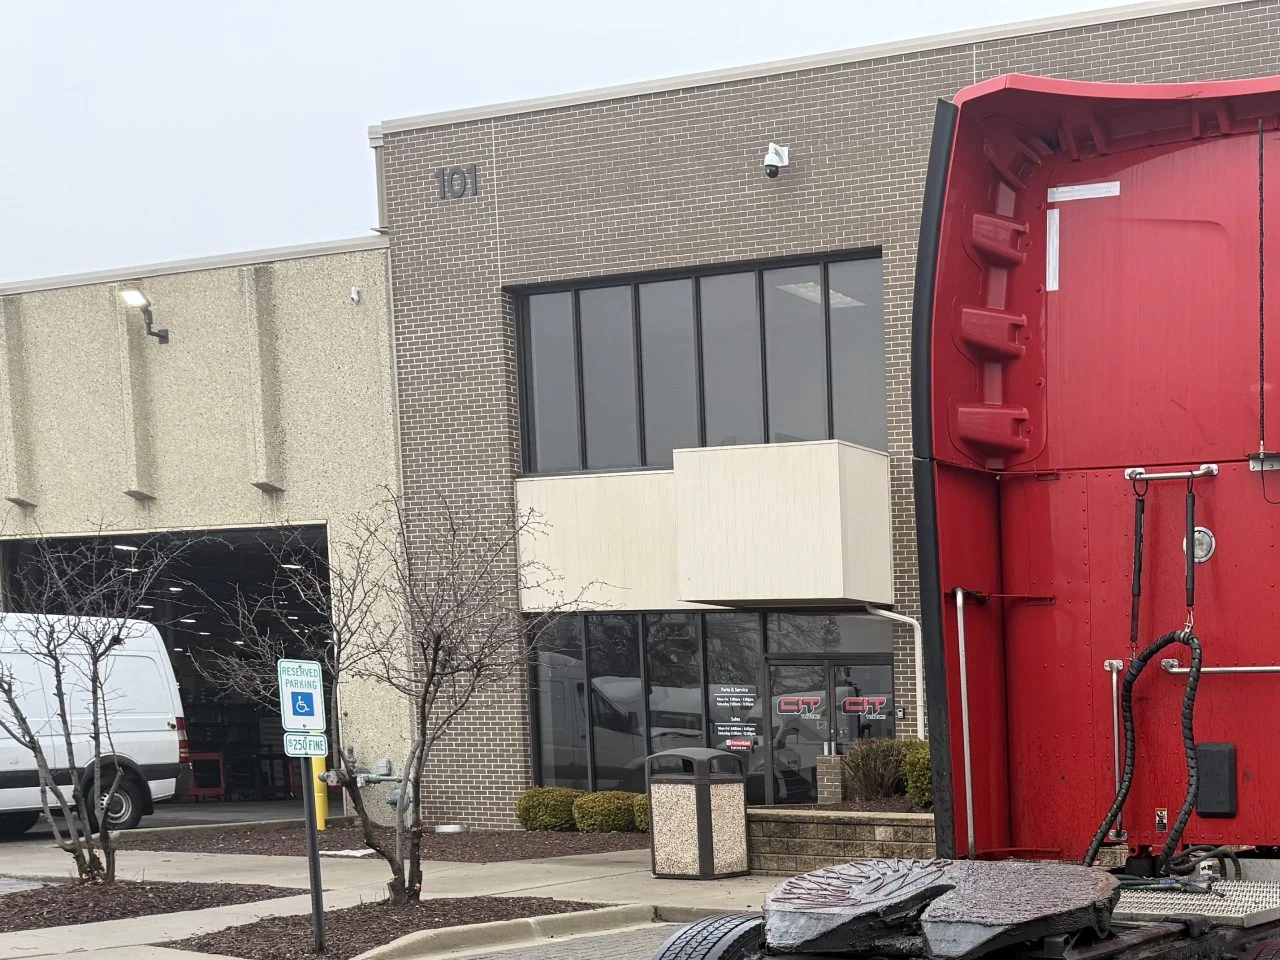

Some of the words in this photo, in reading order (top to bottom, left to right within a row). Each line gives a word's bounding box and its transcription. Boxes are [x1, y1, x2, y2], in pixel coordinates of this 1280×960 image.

[435, 164, 477, 199] 101
[282, 667, 318, 677] RESERVED
[285, 679, 317, 689] PARKING
[777, 697, 821, 714] CIT
[842, 697, 886, 715] CIT
[288, 739, 307, 750] $250
[309, 740, 324, 751] FINE
